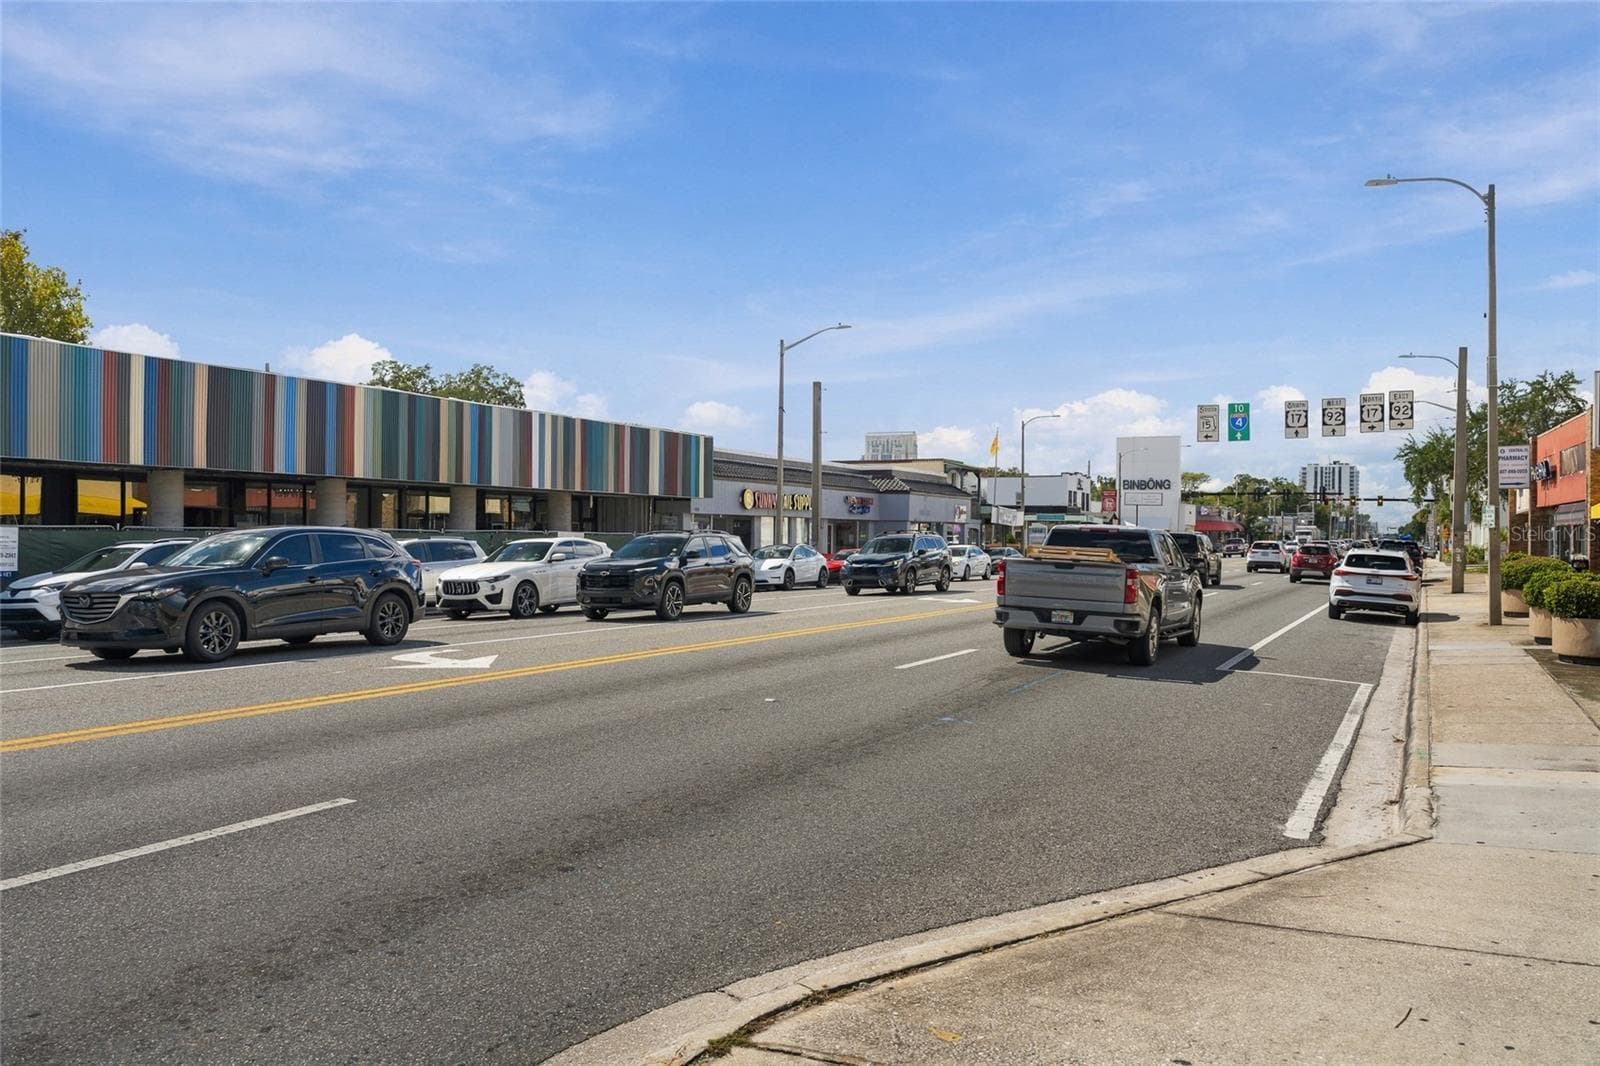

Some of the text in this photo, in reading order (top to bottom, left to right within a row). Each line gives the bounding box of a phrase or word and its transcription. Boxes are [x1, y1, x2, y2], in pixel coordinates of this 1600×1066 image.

[1366, 408, 1378, 418] 17
[1393, 405, 1409, 416] 92
[1291, 413, 1302, 423] 17
[1326, 411, 1342, 421] 92
[1202, 420, 1211, 430] 15
[1235, 417, 1243, 427] 4
[1122, 477, 1171, 490] BINBÔNG
